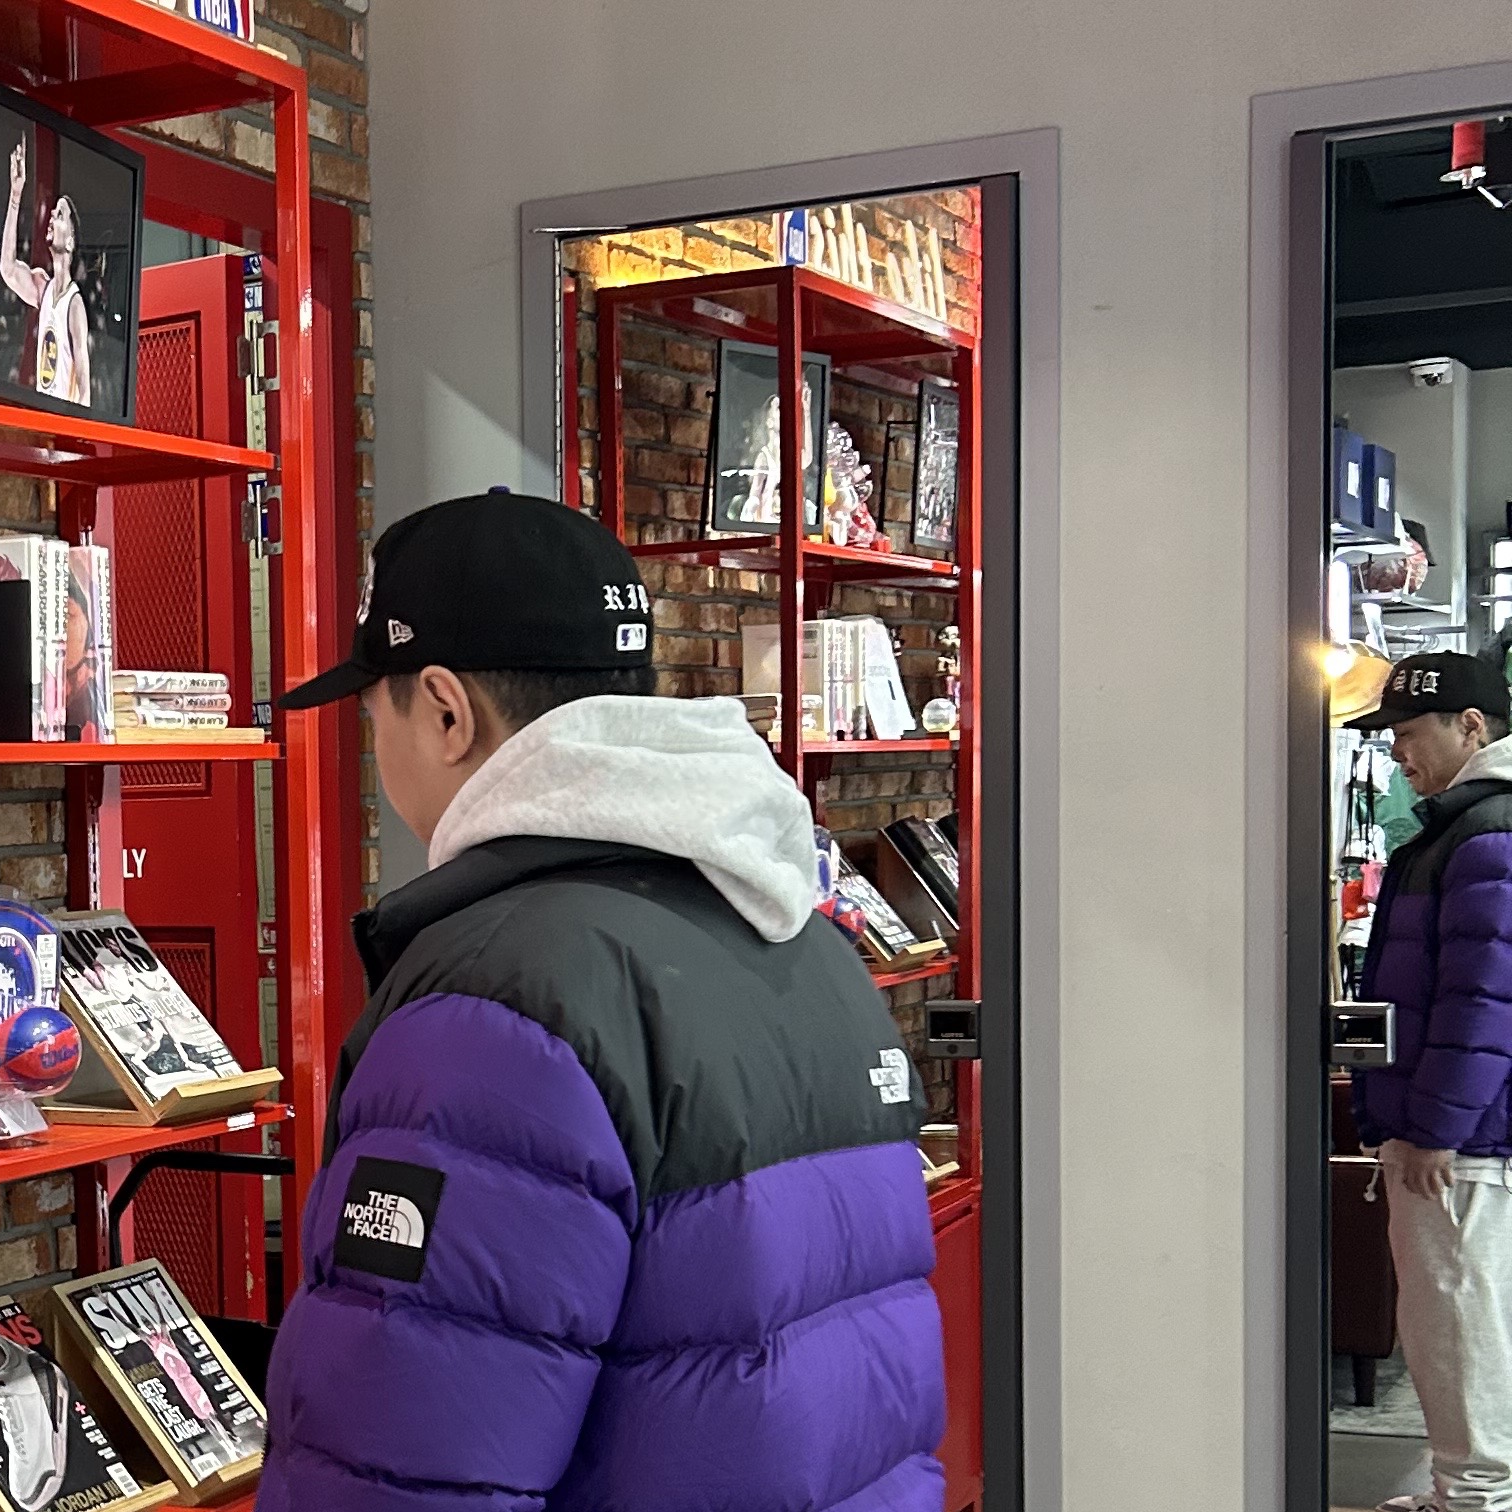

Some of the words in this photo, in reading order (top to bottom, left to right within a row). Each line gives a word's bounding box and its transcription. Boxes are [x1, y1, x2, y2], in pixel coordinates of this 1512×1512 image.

[368, 1190, 399, 1211] THE
[343, 1202, 396, 1226] NORTH
[352, 1219, 391, 1242] FACE
[82, 1277, 189, 1350] SLAM
[137, 1377, 167, 1399] GETS
[147, 1394, 173, 1413] THE
[157, 1405, 187, 1428] LAST
